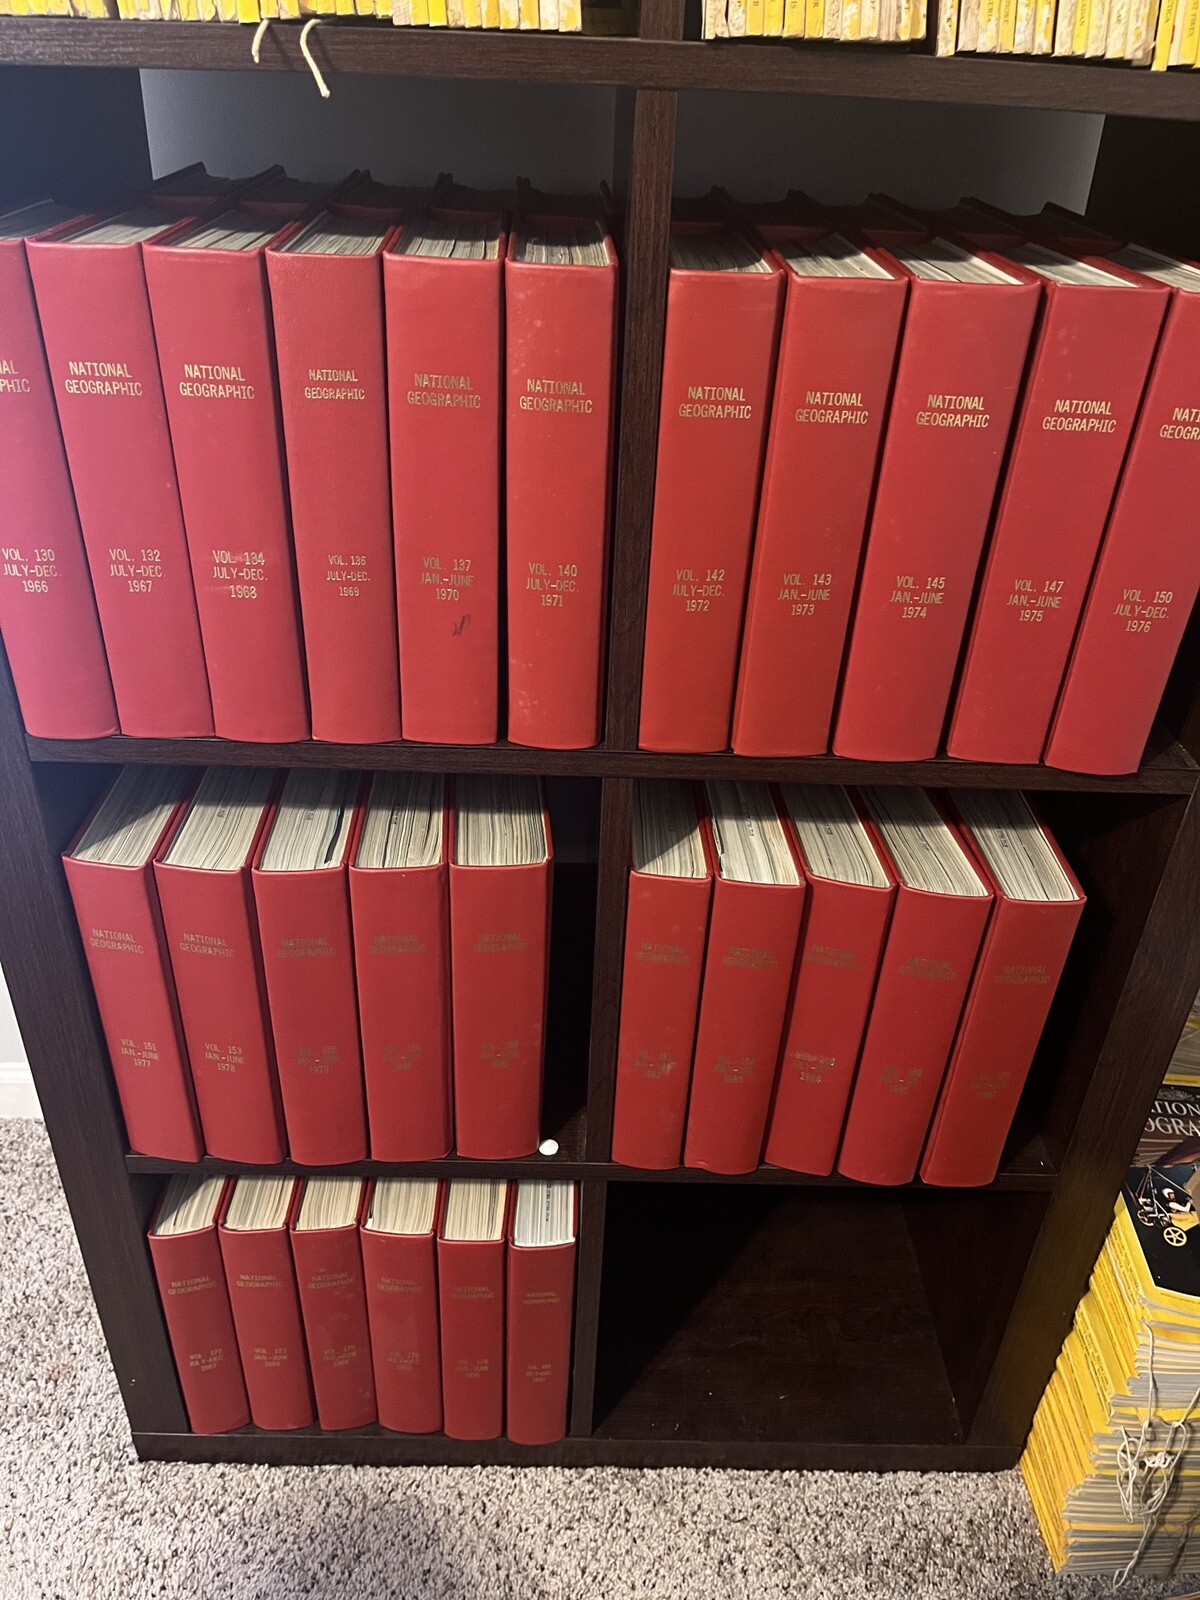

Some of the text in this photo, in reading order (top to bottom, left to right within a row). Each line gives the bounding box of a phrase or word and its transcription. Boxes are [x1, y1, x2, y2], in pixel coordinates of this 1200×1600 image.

[69, 361, 132, 378] NATIONAL
[184, 364, 245, 381] NATIONAL
[309, 369, 358, 382] NATIONAL
[65, 380, 142, 396] GEOGRAPHIC
[414, 374, 473, 390] NATIONAL
[527, 379, 585, 396] NATIONAL
[179, 382, 254, 399] GEOGRAPHIC
[304, 387, 365, 400] GEOGRAPHIC
[688, 387, 745, 401] NATIONAL
[407, 391, 481, 408] GEOGRAPHIC
[519, 396, 593, 414] GEOGRAPHIC
[805, 391, 864, 407] NATIONAL
[926, 394, 985, 411] NATIONAL
[678, 404, 752, 419] GEOGRAPHIC
[1054, 399, 1113, 415] NATIONAL
[795, 408, 868, 425] GEOGRAPHIC
[916, 411, 990, 428] GEOGRAPHIC
[1042, 417, 1116, 433] GEOGRAPHIC
[1159, 424, 1200, 440] GEOGR
[1, 548, 55, 562] VOL. 130
[109, 549, 161, 562] VOL. 132
[213, 550, 236, 564] VOL.
[328, 555, 366, 566] VOL. 136
[4, 563, 62, 577] JULY-DEC.
[110, 564, 166, 578] JULY-DEC.
[423, 557, 472, 572] VOL. 137
[528, 562, 578, 577] VOL. 140
[213, 568, 268, 581] JULY-DEC.
[326, 570, 371, 582] JULY-DEC.
[420, 572, 474, 586] JAN.-JUNE
[676, 569, 725, 581] VOL. 142
[783, 574, 832, 586] VOL. 143
[22, 580, 48, 593] 1966
[128, 580, 152, 593] 1967
[526, 578, 580, 592] JULY-DEC.
[896, 576, 945, 590] VOL. 145
[1014, 579, 1064, 593] VOL. 147
[230, 585, 257, 599] 1968
[339, 586, 360, 597] 1969
[435, 588, 460, 601] 1970
[672, 585, 725, 597] JULY-DEC.
[777, 588, 831, 601] JAN.-JUNE
[889, 591, 944, 604] JAN.-JUNE
[1122, 589, 1173, 603] VOL. 150
[541, 594, 564, 607] 1971
[685, 600, 710, 612] 1972
[1006, 594, 1062, 608] JAN.-JUNE
[790, 604, 815, 616] 1973
[902, 607, 927, 619] 1974
[1019, 609, 1043, 622] 1975
[1113, 604, 1169, 619] JULY-DEC.
[1125, 620, 1151, 633] 1976
[92, 929, 136, 943] NATIONAL
[183, 933, 228, 947] NATIONAL
[90, 938, 144, 954] GEOGRAPHIC
[179, 942, 235, 958] GEOGRAPHIC
[143, 1041, 157, 1051] 151
[133, 1058, 151, 1068] 1977
